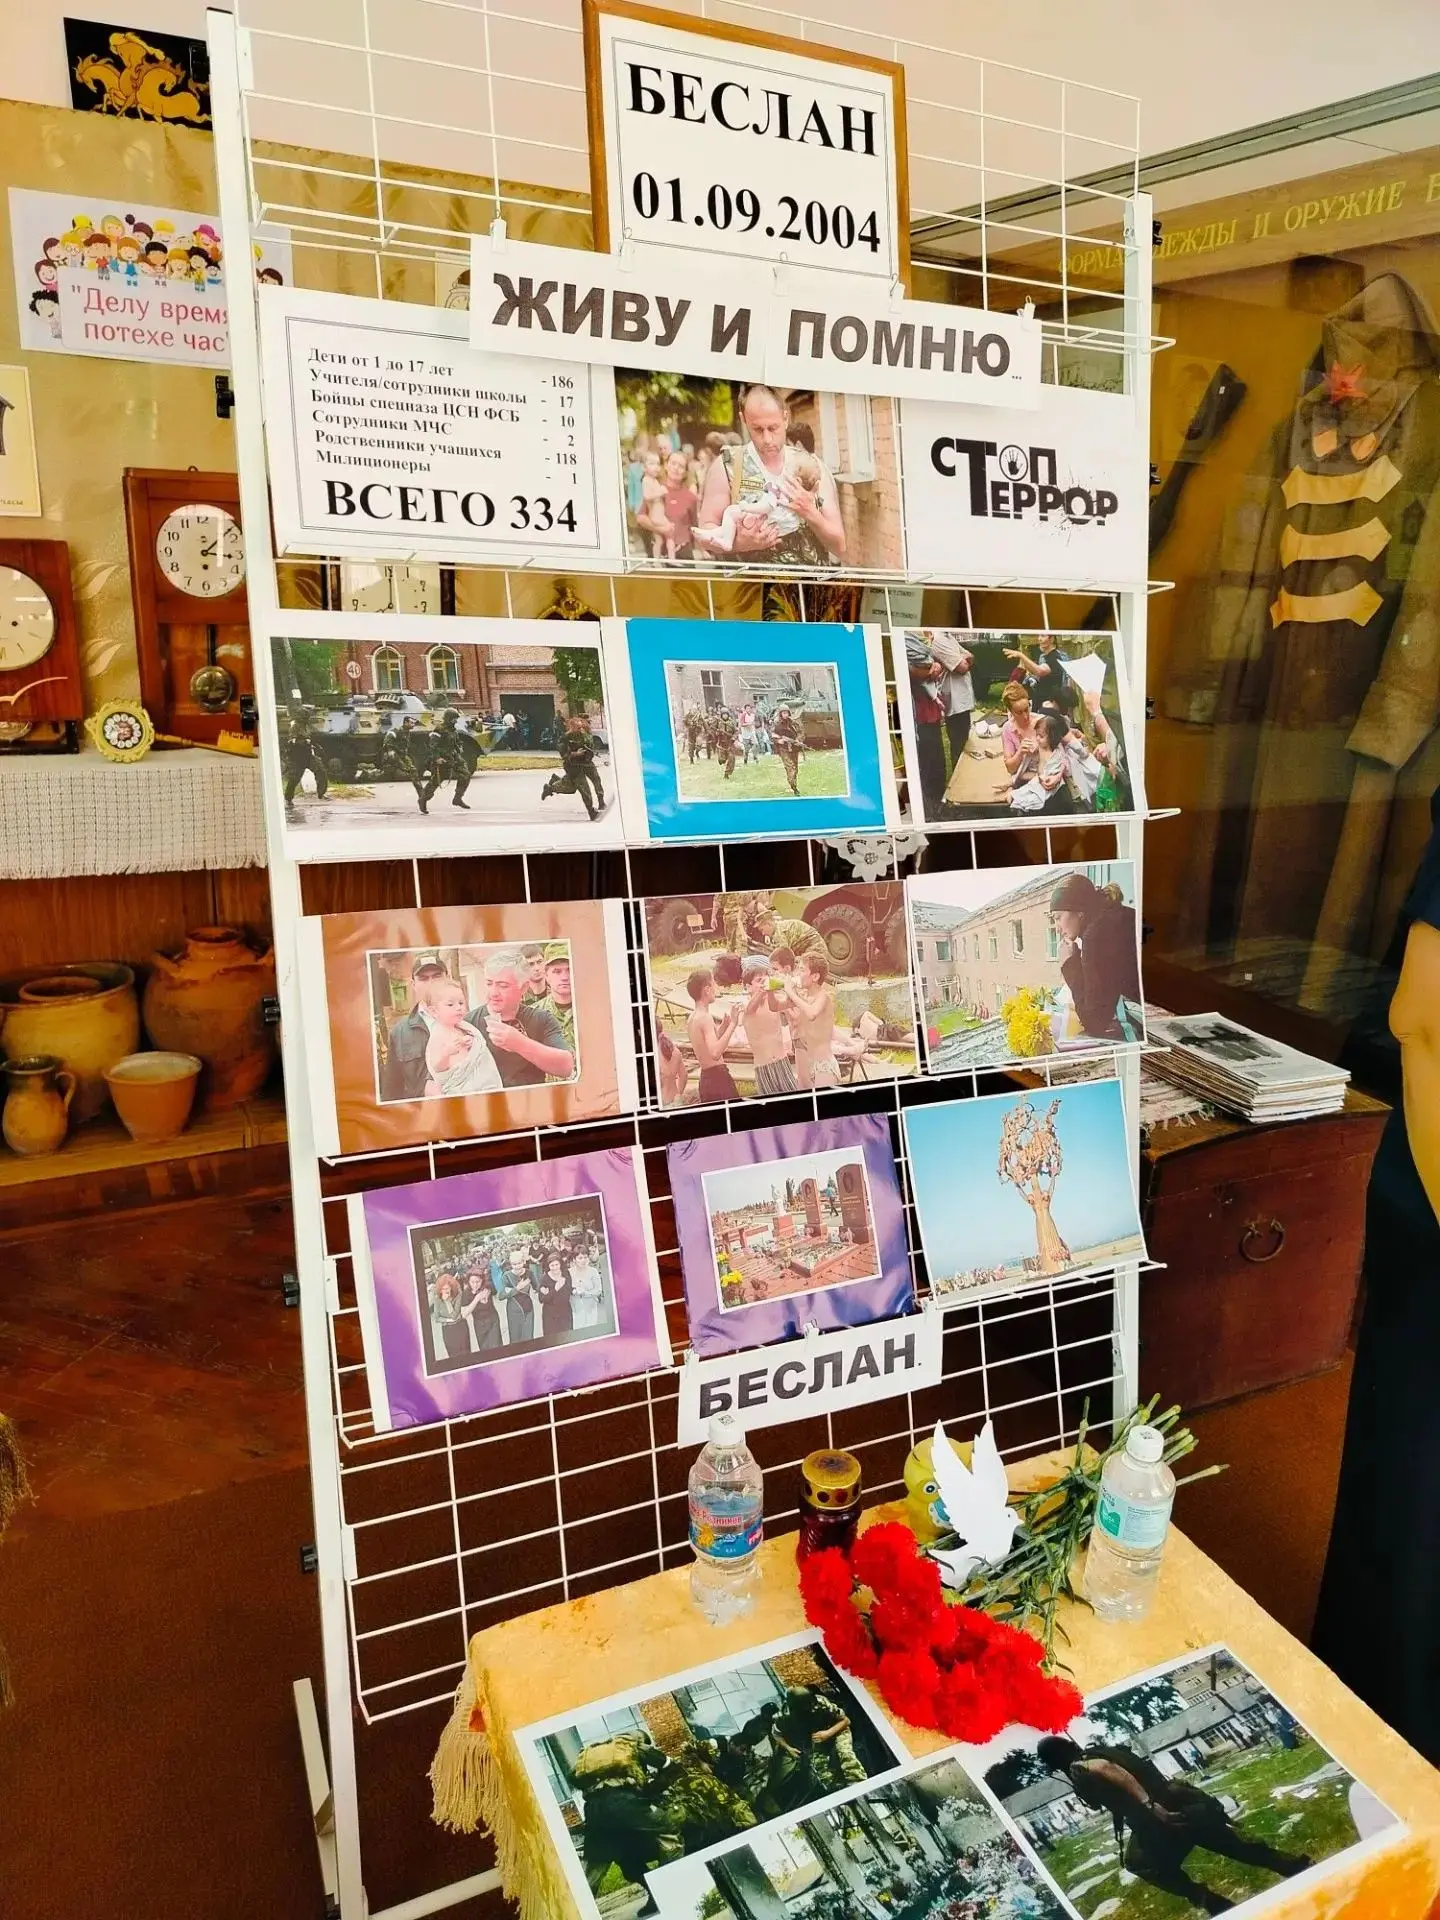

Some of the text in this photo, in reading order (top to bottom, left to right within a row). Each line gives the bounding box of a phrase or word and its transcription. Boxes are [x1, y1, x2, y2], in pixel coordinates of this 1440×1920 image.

[623, 61, 880, 157] БЕСЛАН
[632, 172, 881, 253] 01.09.2004
[1153, 219, 1238, 259] ДЕЖДЫ
[1251, 212, 1272, 239] И
[1284, 181, 1407, 232] ОРУЖИЕ
[492, 272, 691, 347] ЖИВУ
[711, 304, 751, 356] И
[84, 322, 174, 348] потехе
[308, 348, 347, 364] Дети
[352, 356, 370, 368] от
[373, 356, 381, 369] 1
[385, 359, 403, 373] до
[408, 360, 424, 374] 17
[429, 364, 455, 377] лет
[309, 368, 471, 398] Учителя/сотрудники
[475, 389, 527, 405] школы
[560, 396, 574, 408] 17
[311, 389, 365, 408] Бойцы
[370, 399, 438, 416] спецназа
[443, 403, 479, 419] ЦСН
[484, 408, 520, 423] ФСБ
[560, 415, 575, 428] 10
[312, 409, 408, 432] Сотрудники
[413, 419, 452, 435] МЧС
[567, 434, 574, 447] 2
[314, 429, 425, 452] Родственники
[430, 442, 502, 460] учащихся
[316, 450, 431, 474] Милиционеры
[572, 471, 577, 485] 1
[930, 436, 1057, 516] СТОП
[957, 446, 1119, 526] ТЕРРОР
[196, 516, 209, 524] 12
[322, 479, 578, 533] ВСЕГО 334
[167, 531, 180, 541] 10
[181, 518, 189, 529] 11
[164, 546, 173, 557] 9
[170, 562, 180, 573] 8
[184, 575, 192, 587] 7
[230, 564, 239, 574] 4
[202, 581, 211, 591] 6
